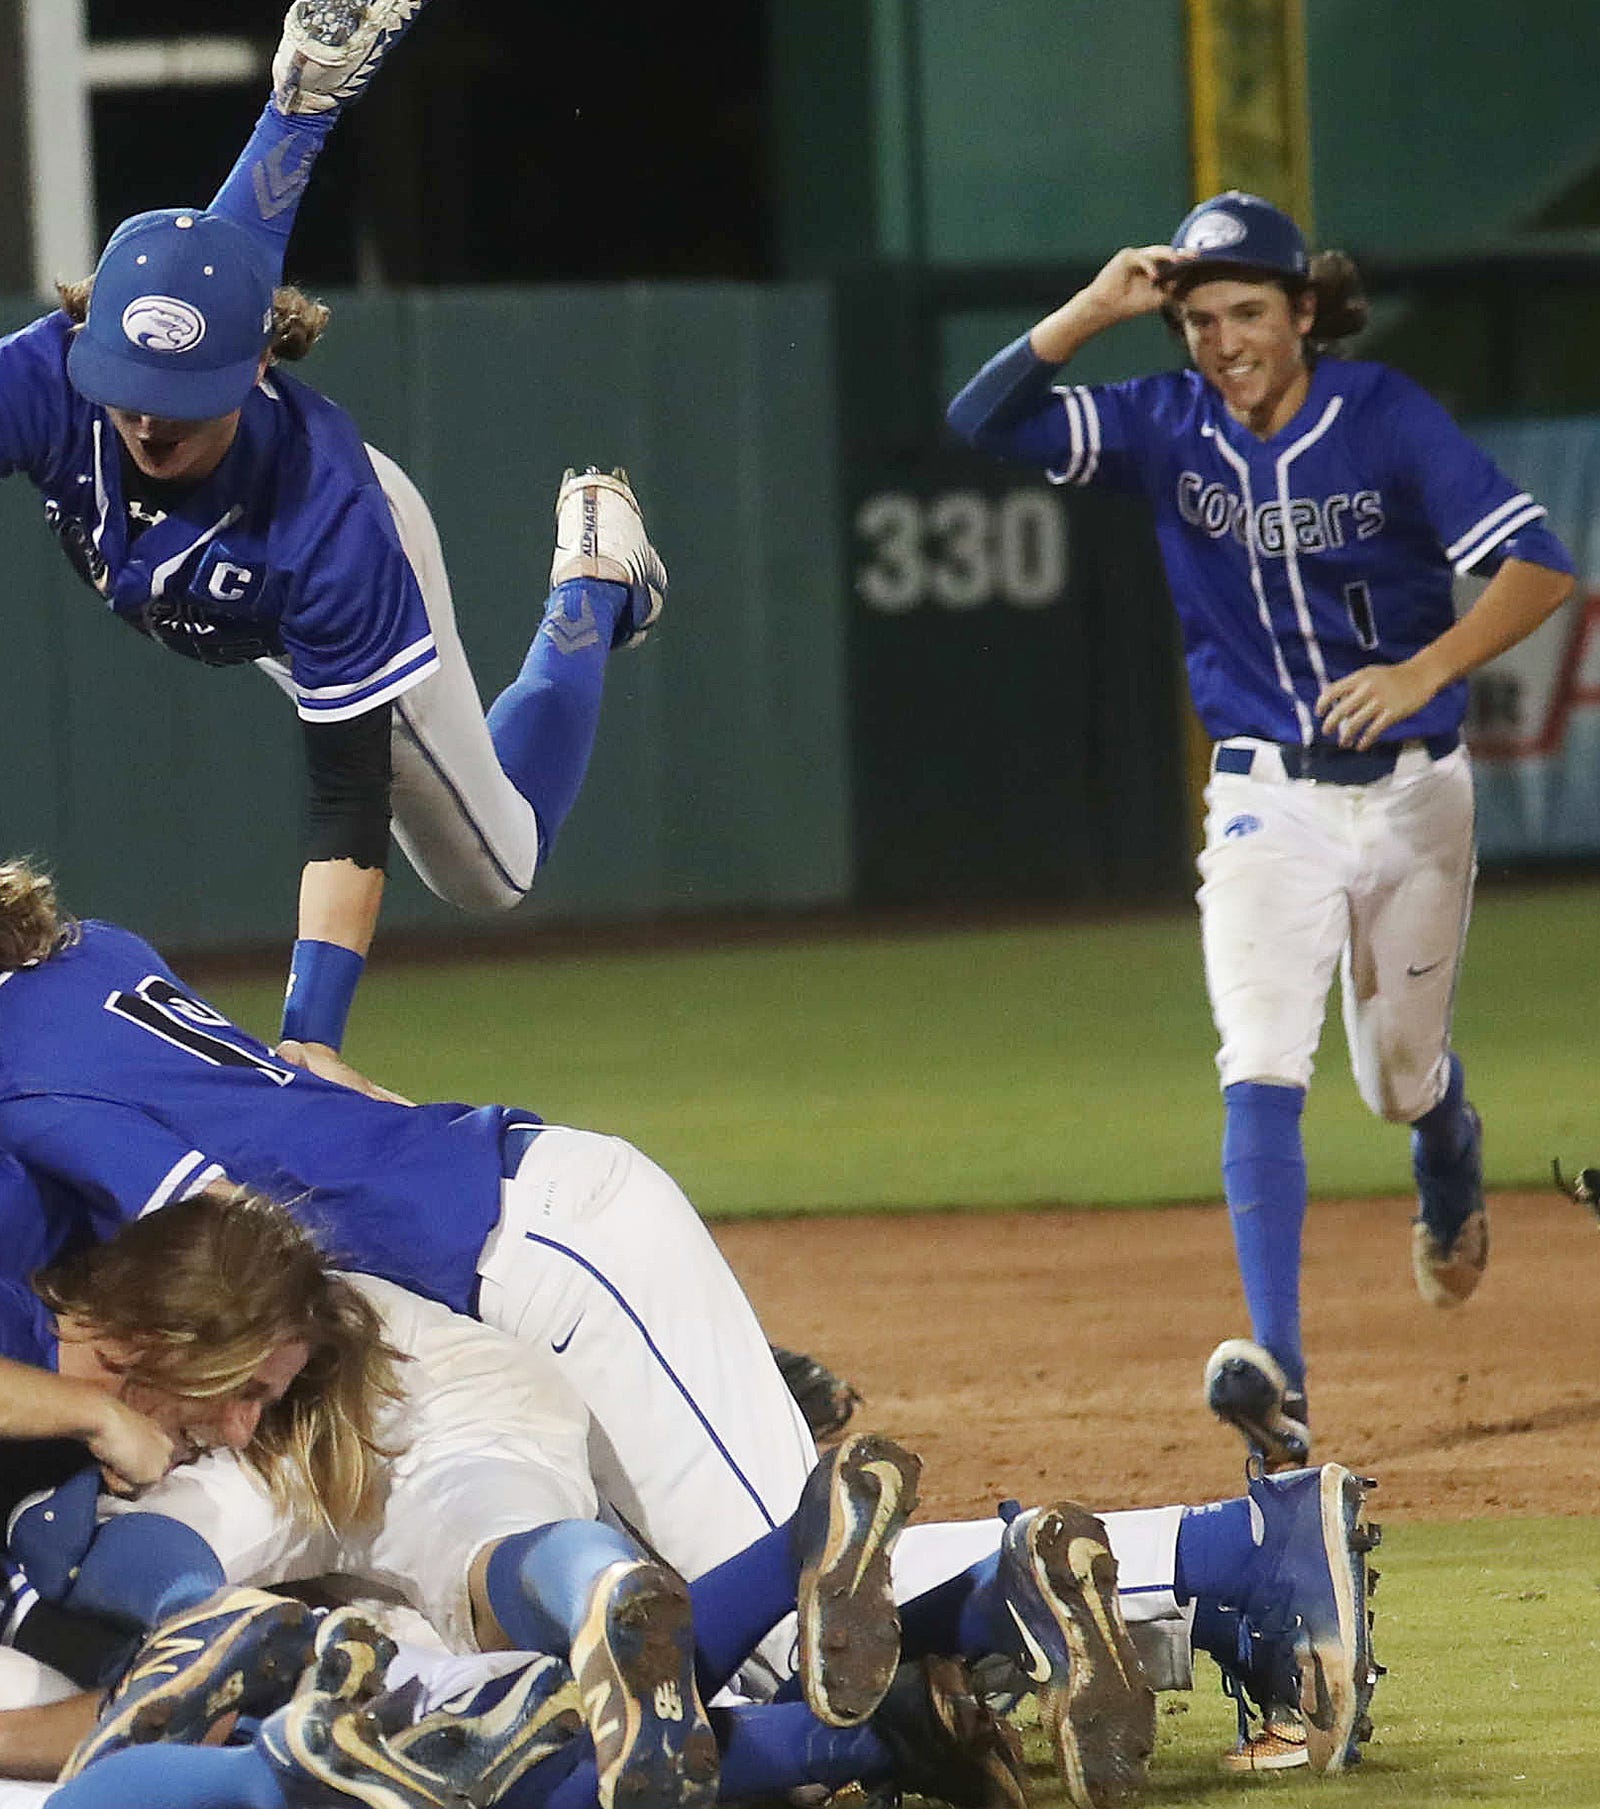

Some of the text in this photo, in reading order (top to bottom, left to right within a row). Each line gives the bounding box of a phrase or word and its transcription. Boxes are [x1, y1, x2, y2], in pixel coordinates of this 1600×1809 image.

[208, 562, 252, 600] C
[855, 489, 1069, 612] 330
[1344, 580, 1378, 651] 1
